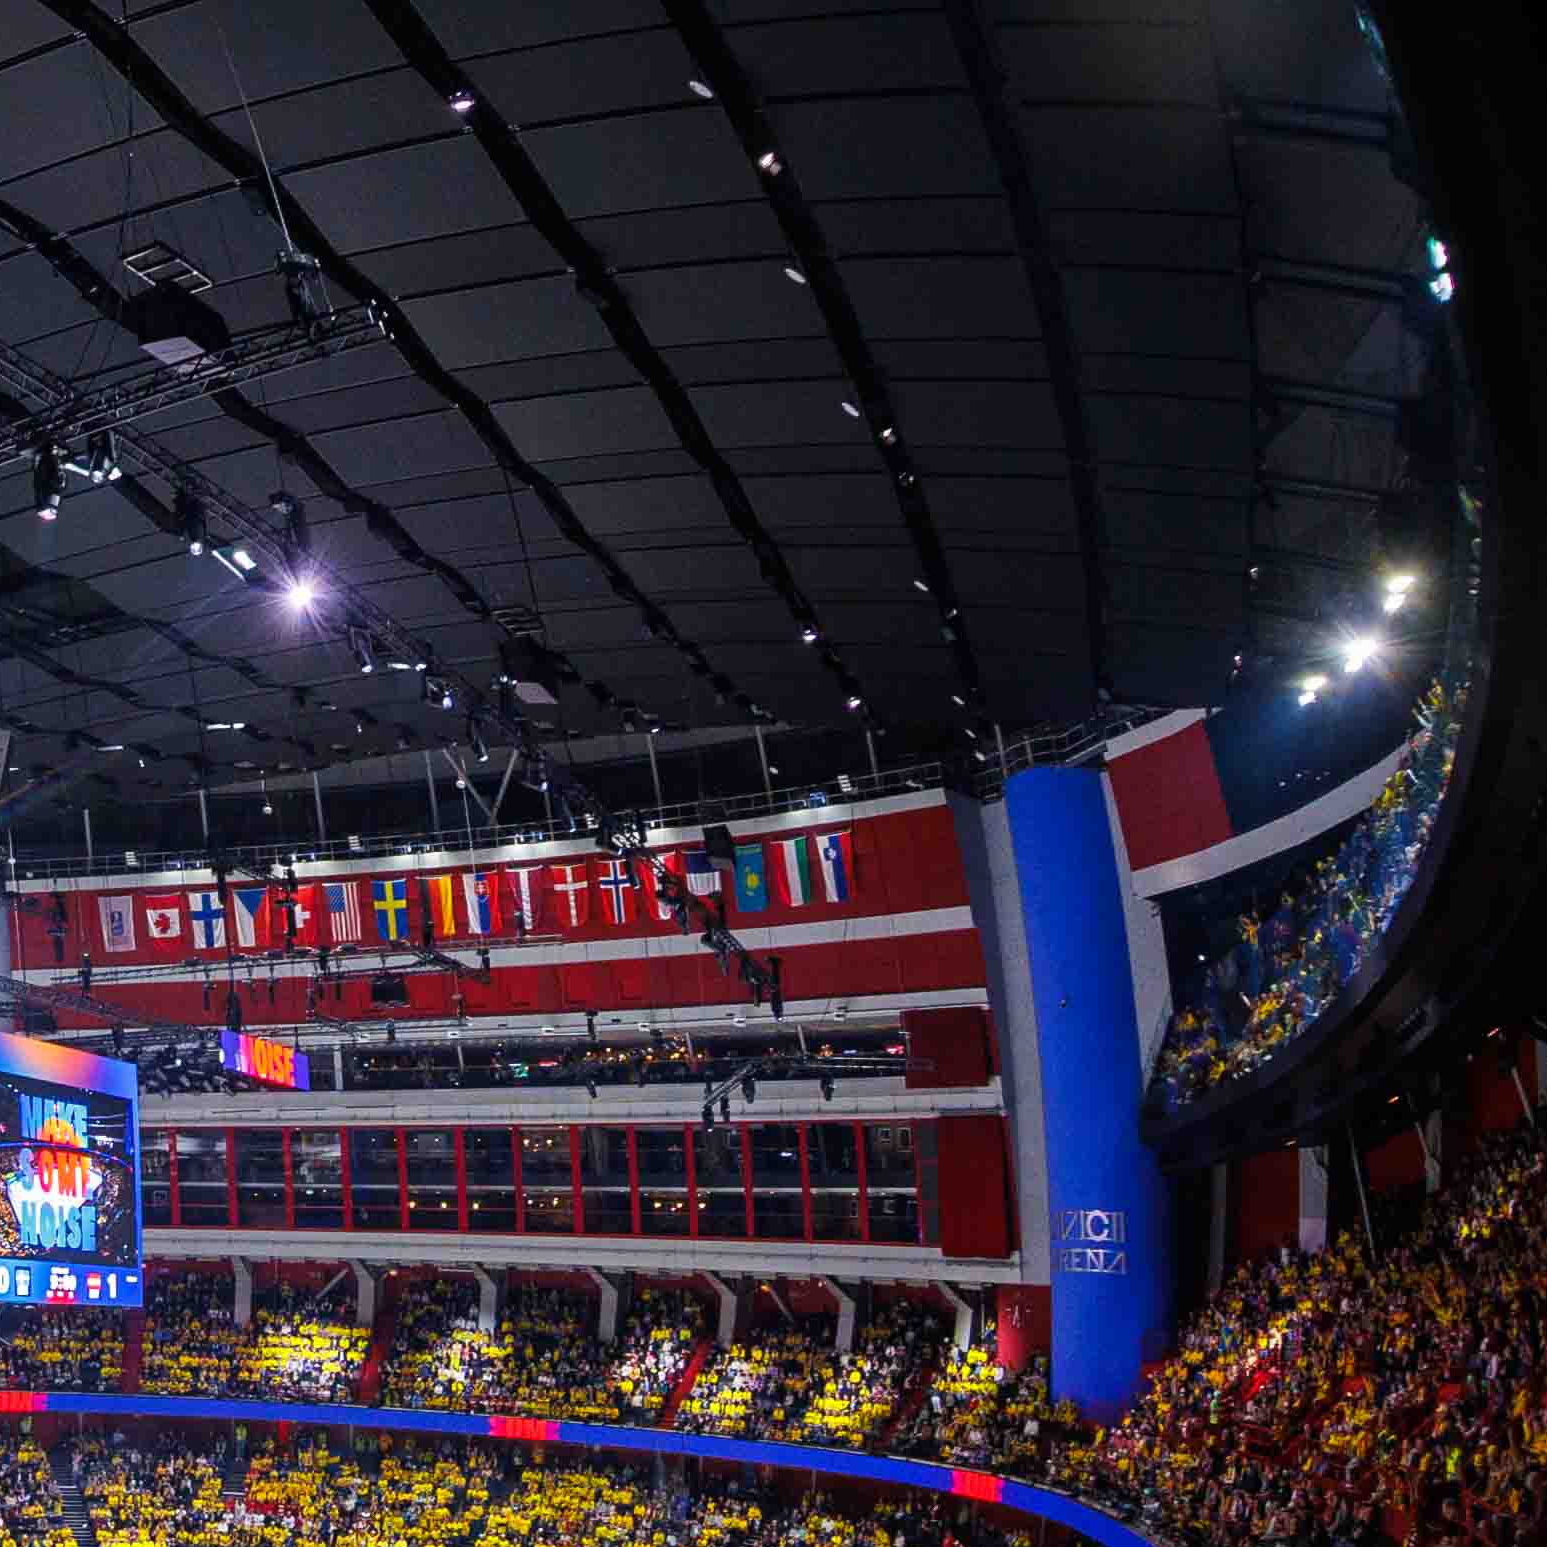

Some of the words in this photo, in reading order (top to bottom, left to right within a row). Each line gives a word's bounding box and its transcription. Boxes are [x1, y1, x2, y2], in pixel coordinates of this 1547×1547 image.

[239, 1034, 296, 1088] NOISE
[20, 1094, 89, 1149] MAKE
[19, 1148, 93, 1200] SOME
[21, 1200, 96, 1252] NOISE
[107, 1273, 117, 1299] 1
